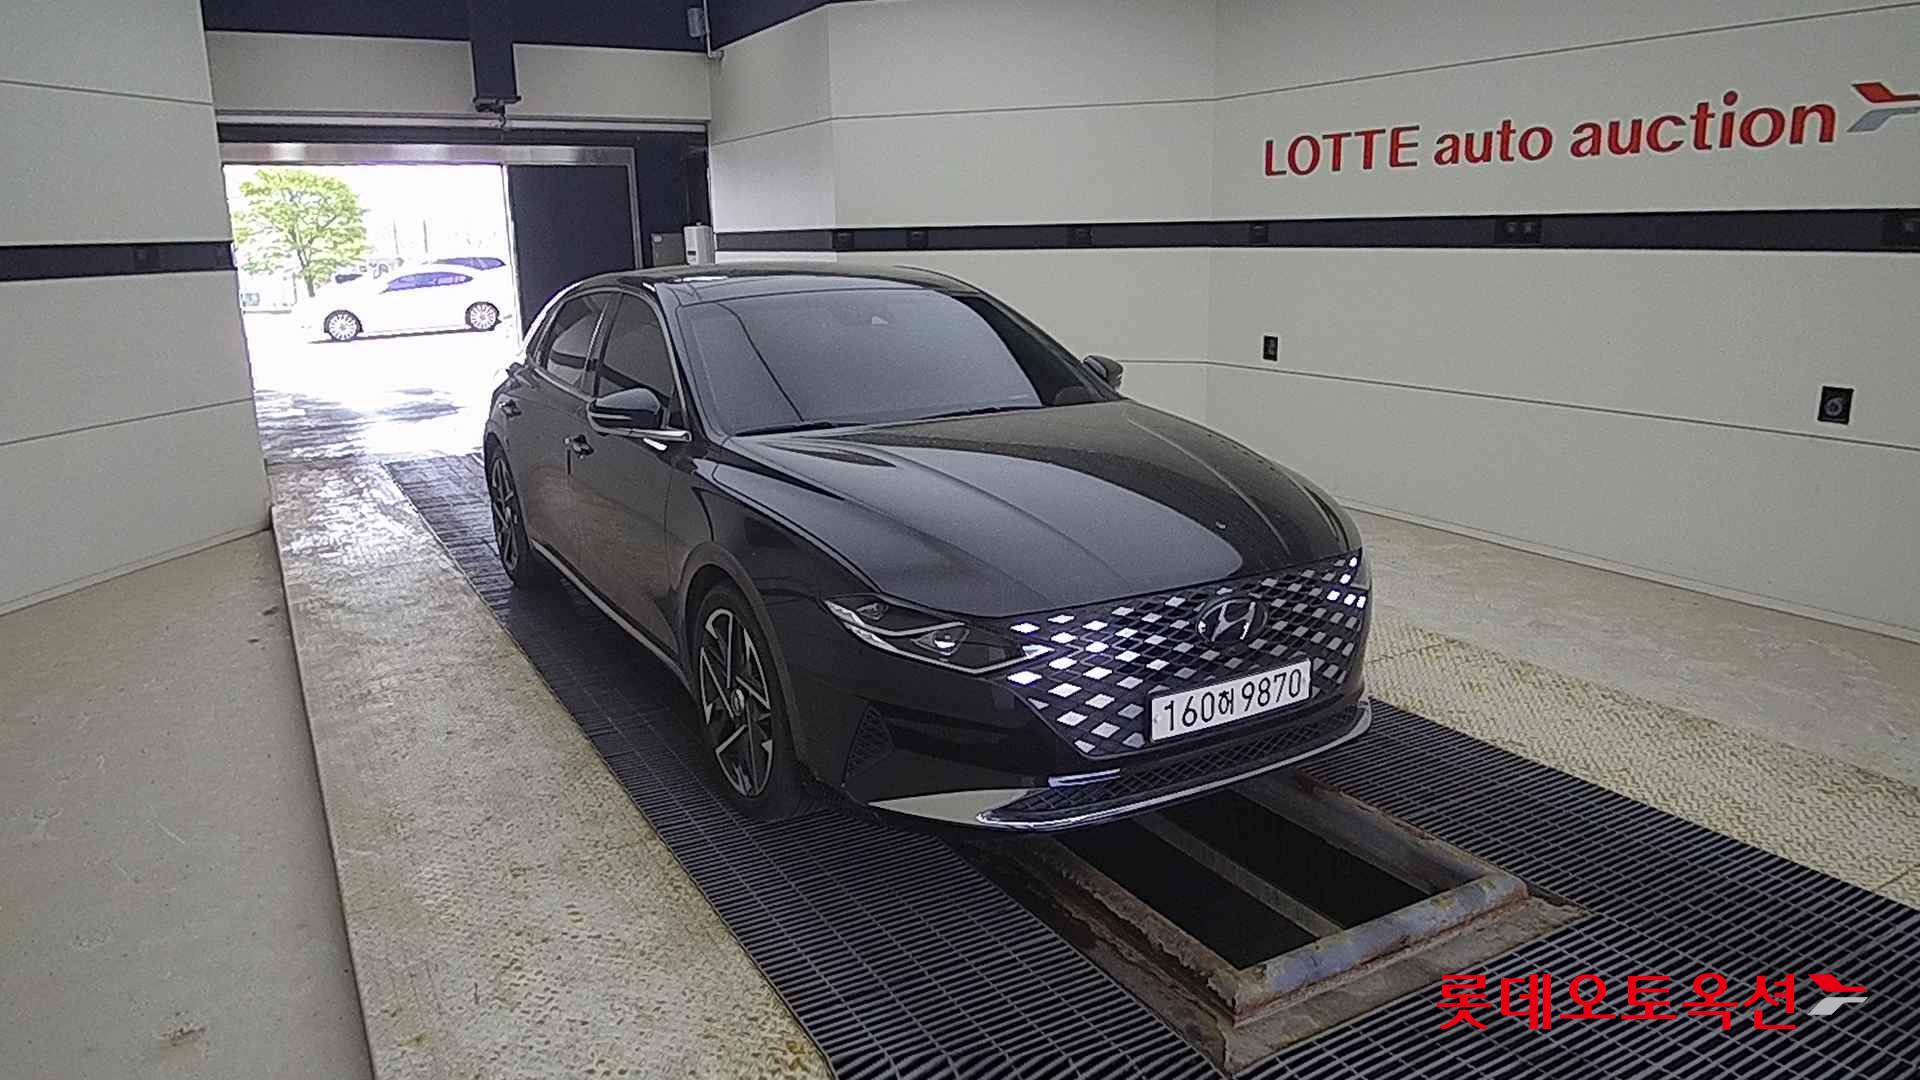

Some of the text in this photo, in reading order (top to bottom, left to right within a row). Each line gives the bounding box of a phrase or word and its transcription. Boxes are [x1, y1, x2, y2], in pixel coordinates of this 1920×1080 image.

[1264, 90, 1836, 177] LOTTE auto auction
